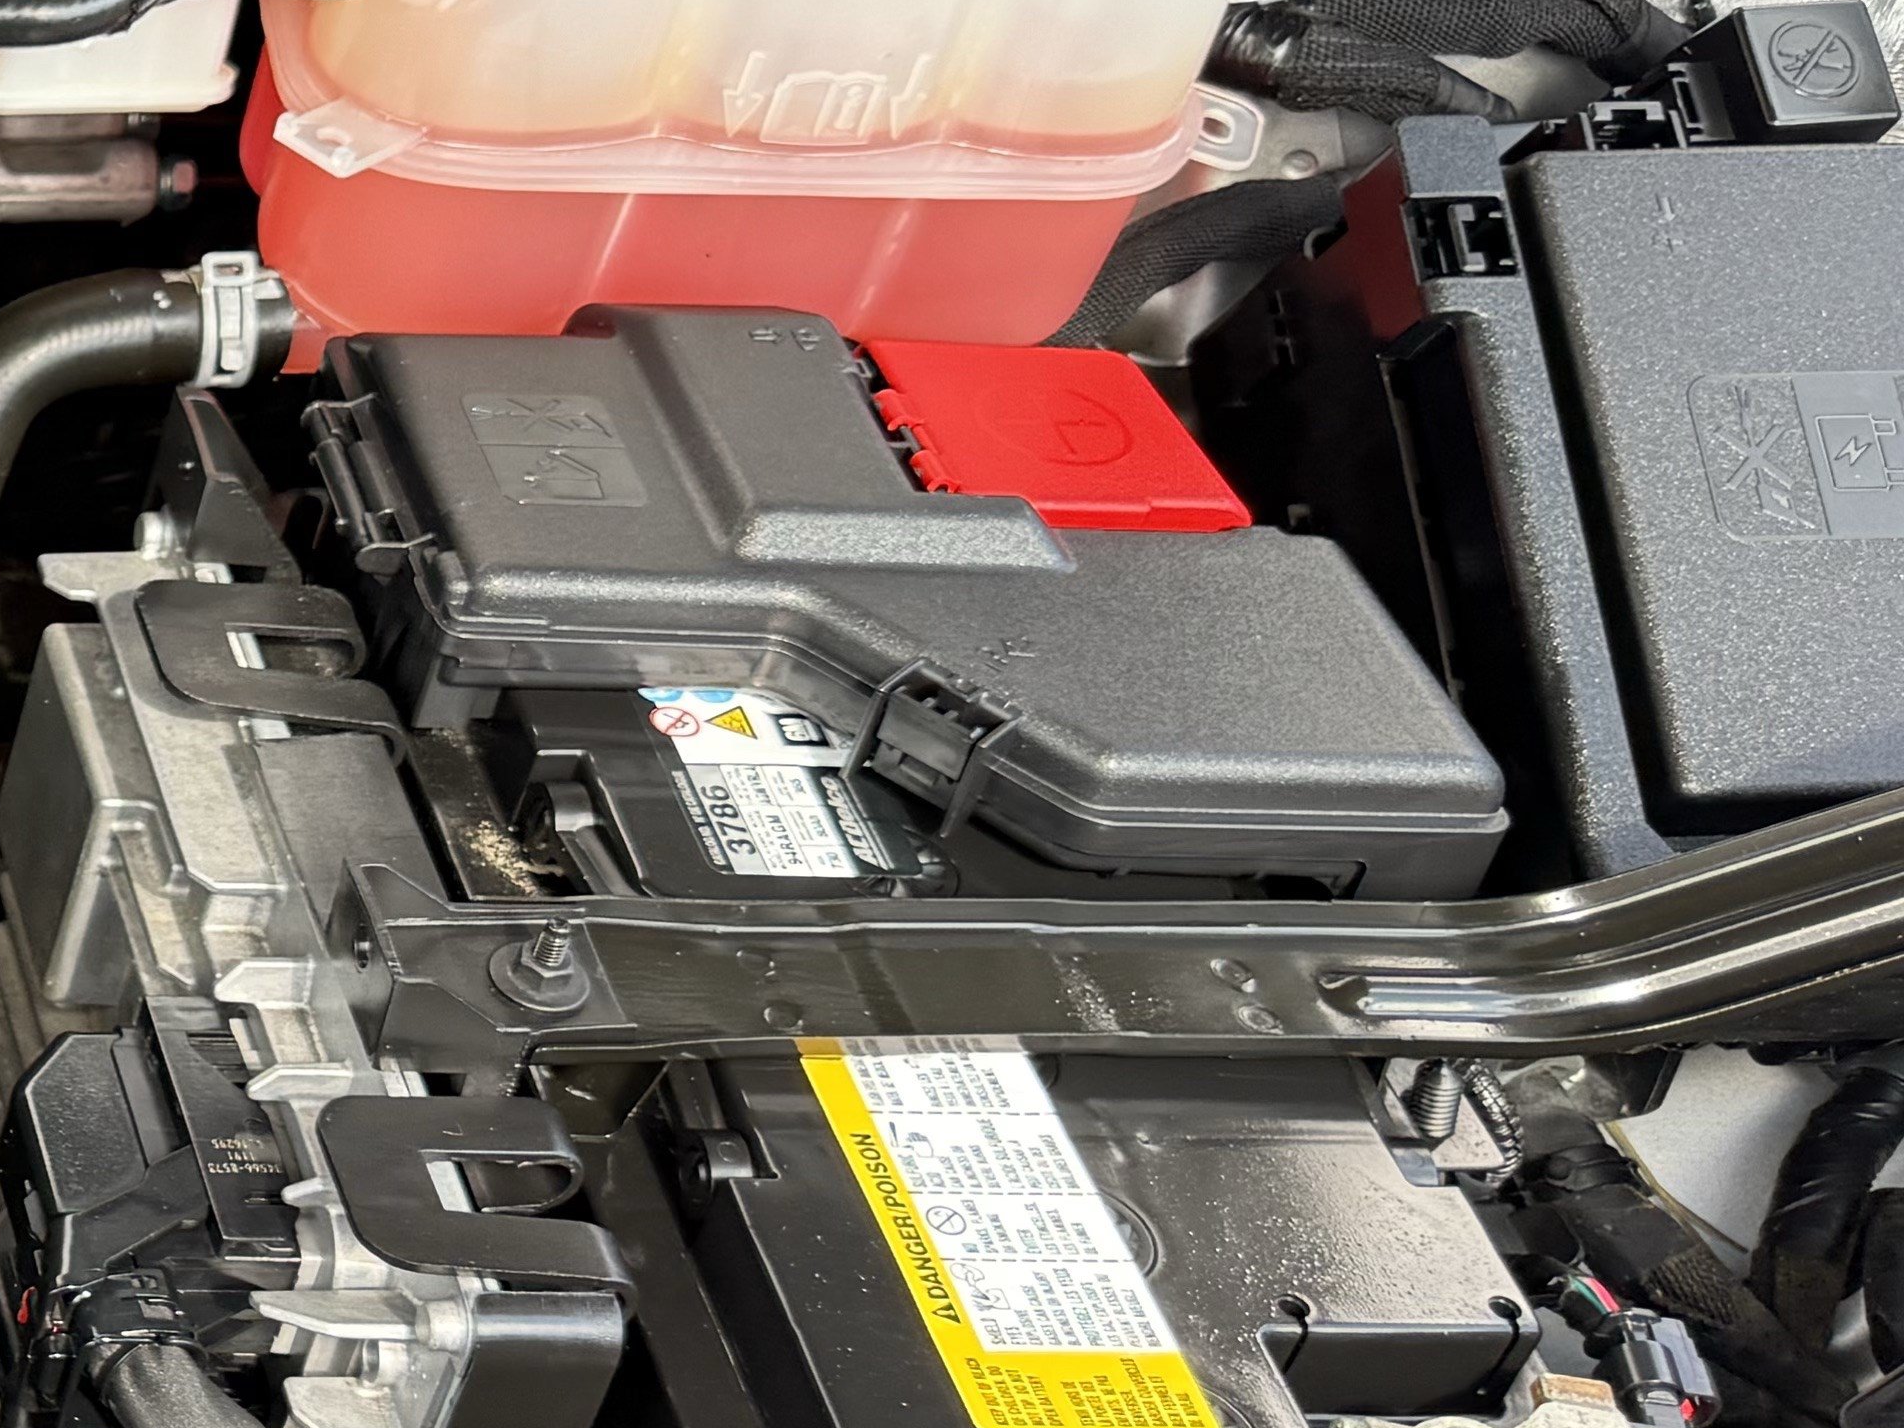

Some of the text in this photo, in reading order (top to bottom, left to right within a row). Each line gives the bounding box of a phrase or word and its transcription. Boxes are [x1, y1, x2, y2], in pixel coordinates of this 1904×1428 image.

[699, 784, 758, 856] 3786
[820, 775, 880, 868] ACDelco
[849, 1133, 950, 1300] DANGER/POISON
